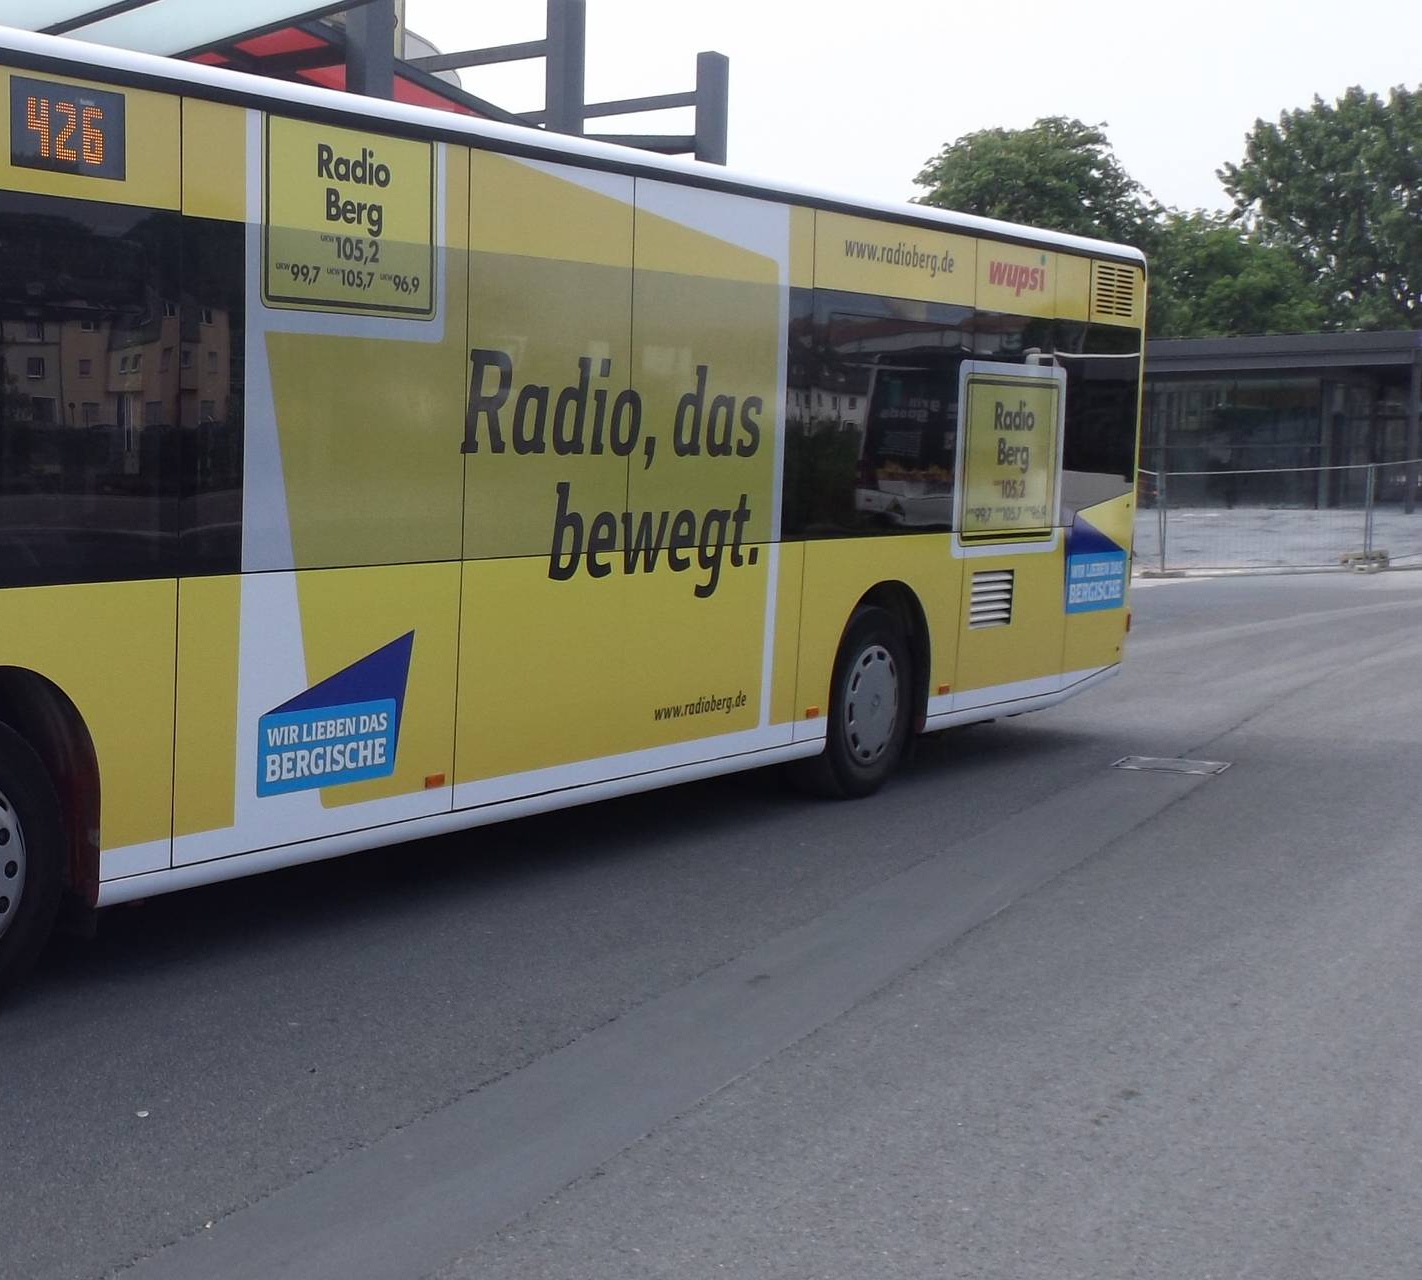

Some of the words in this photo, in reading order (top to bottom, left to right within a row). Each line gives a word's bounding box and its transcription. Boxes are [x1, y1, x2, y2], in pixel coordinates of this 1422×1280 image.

[26, 95, 104, 165] 426
[317, 143, 391, 188] Radio
[326, 187, 383, 238] Berg
[335, 236, 380, 265] 105,2
[845, 239, 954, 278] www.radioberg.de
[290, 263, 321, 286] 99,7
[341, 269, 375, 291] 105,7
[393, 274, 420, 295] 96,9
[989, 254, 1046, 296] wupsi
[460, 348, 656, 470] Radio,
[672, 366, 763, 459] das
[994, 401, 1035, 432] Radio
[996, 437, 1029, 474] Berg
[547, 482, 760, 599] bewegt.
[1068, 580, 1122, 604] BERGISCHE
[654, 690, 747, 721] www.radioberg.de
[267, 725, 299, 747] WIR
[302, 717, 357, 742] LIEBEN
[359, 712, 388, 734] DAS
[266, 737, 387, 783] BERGISCHE
